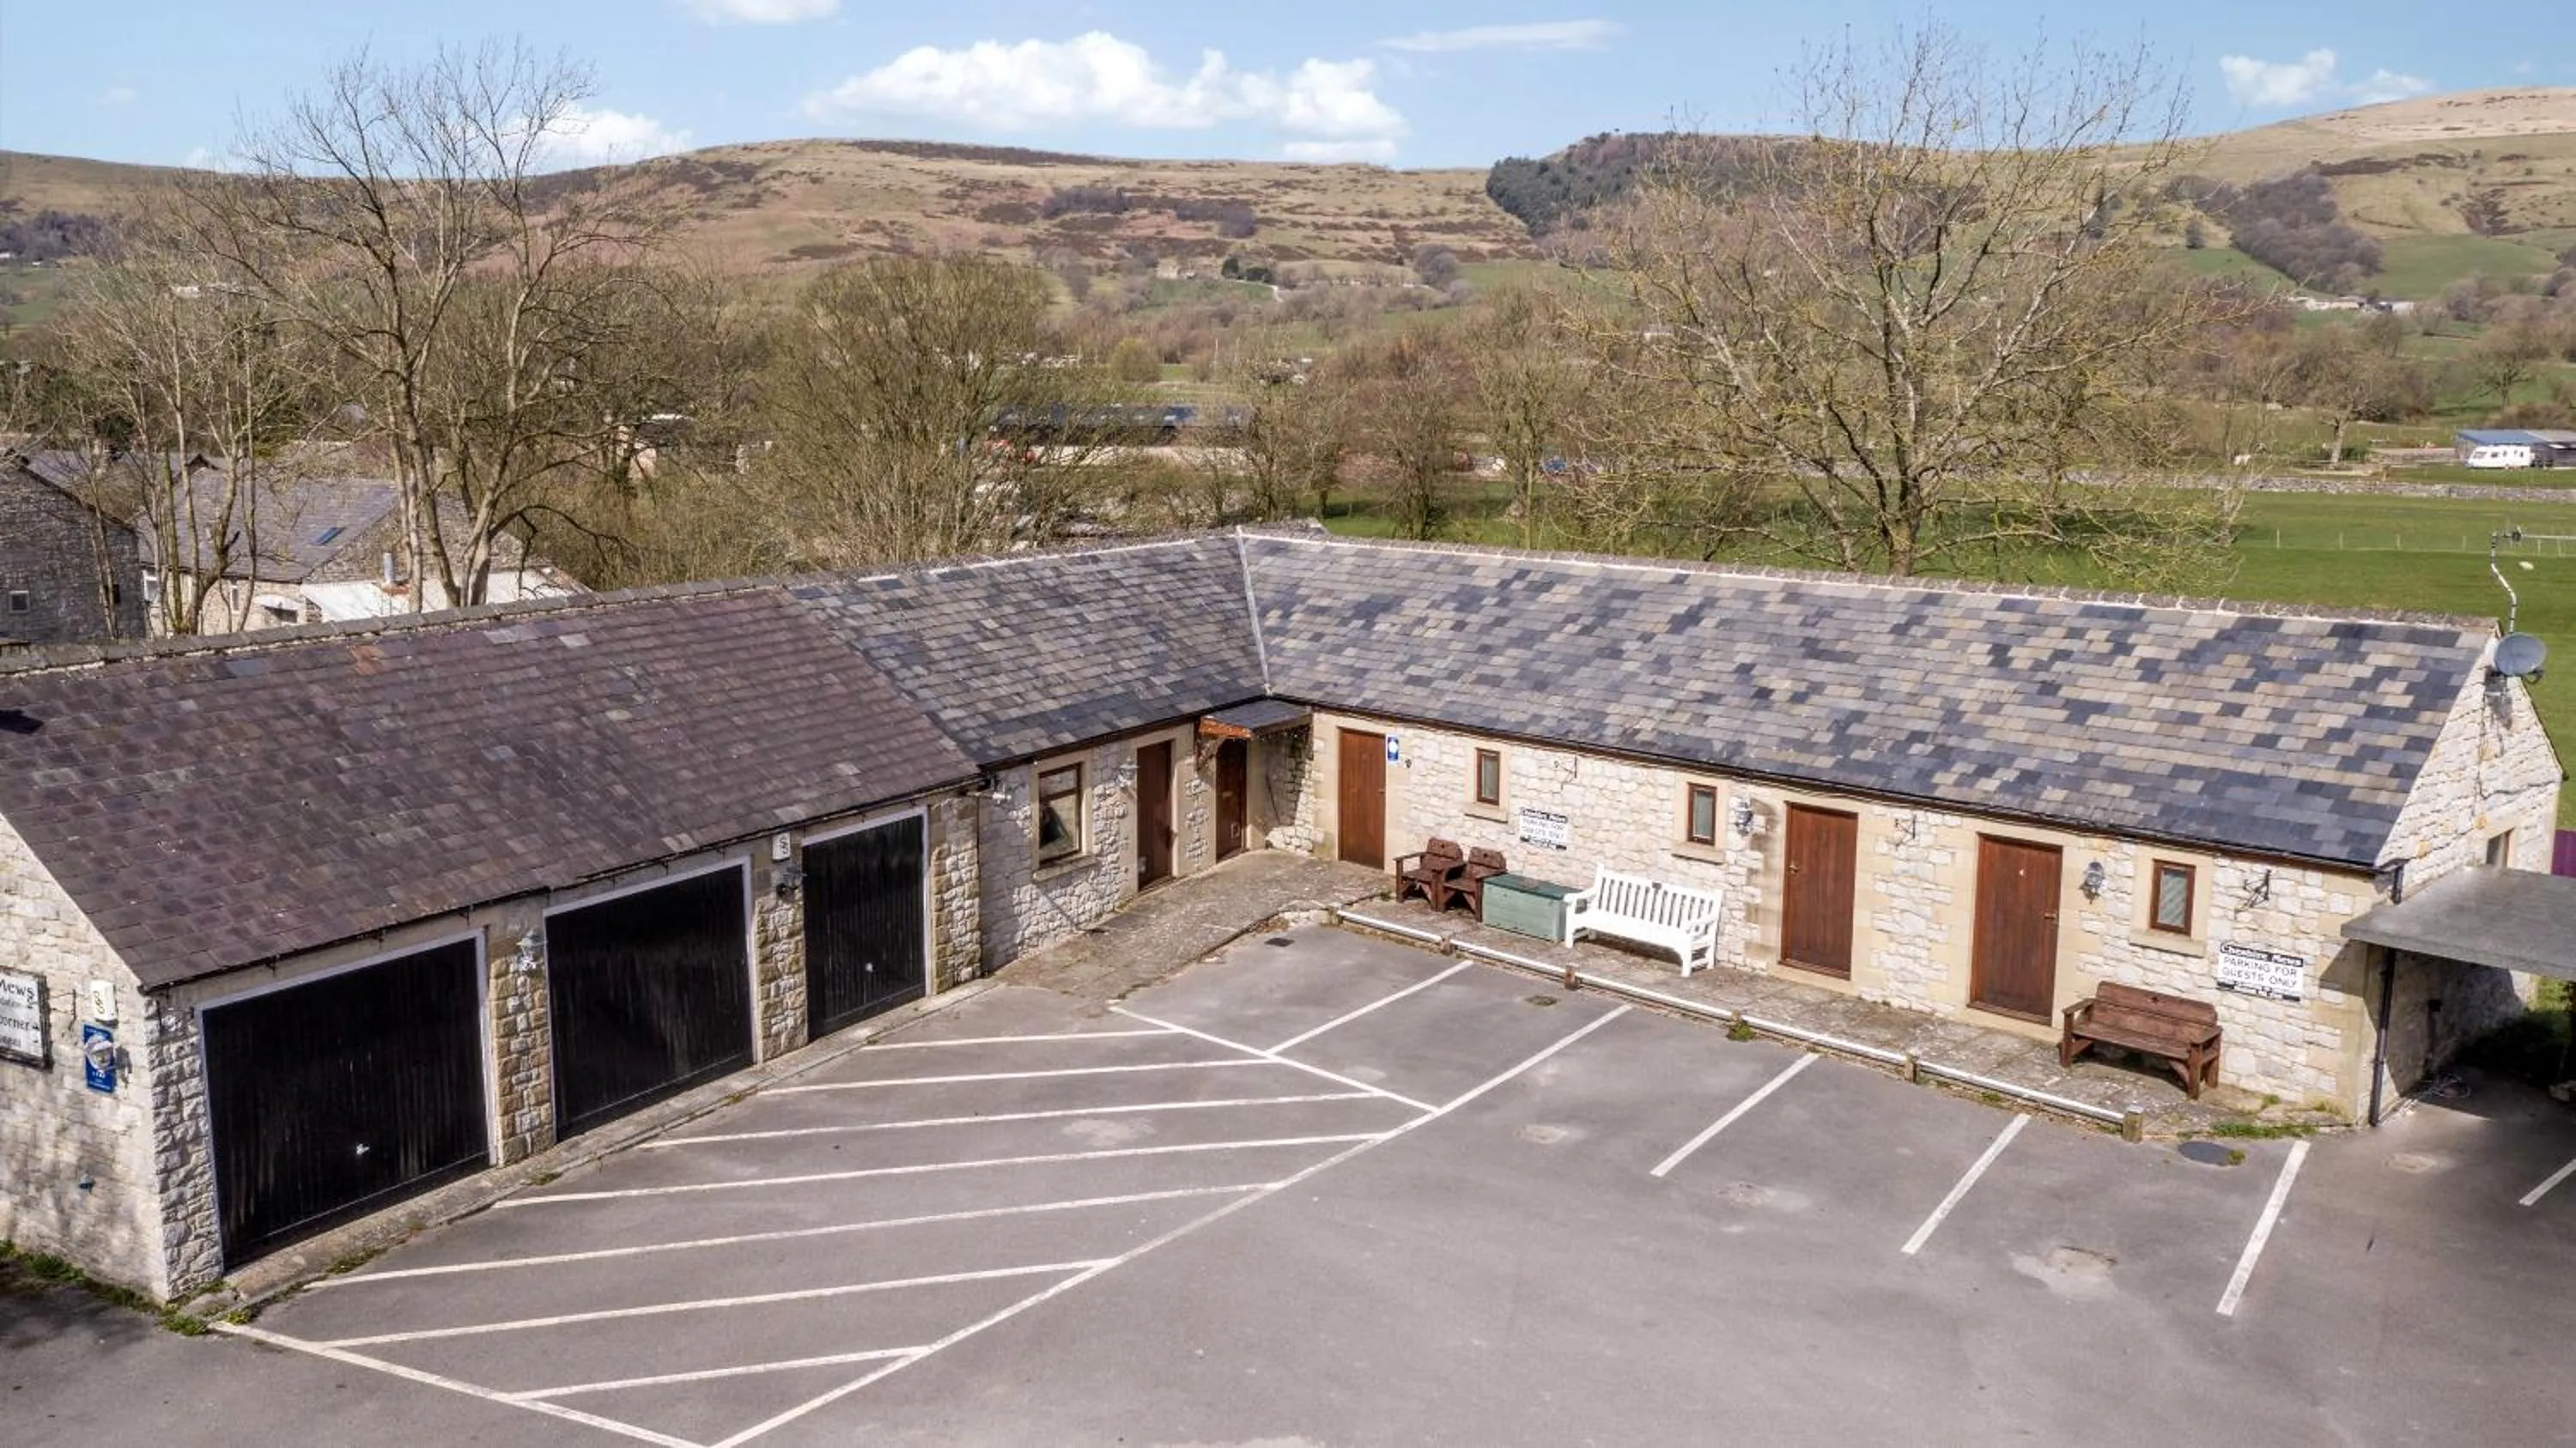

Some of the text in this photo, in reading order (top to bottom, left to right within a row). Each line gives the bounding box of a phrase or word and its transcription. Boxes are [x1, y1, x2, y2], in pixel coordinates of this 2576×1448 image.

[2222, 966, 2297, 989] GUESTS ONLY
[2223, 956, 2297, 977] PARKING FOR
